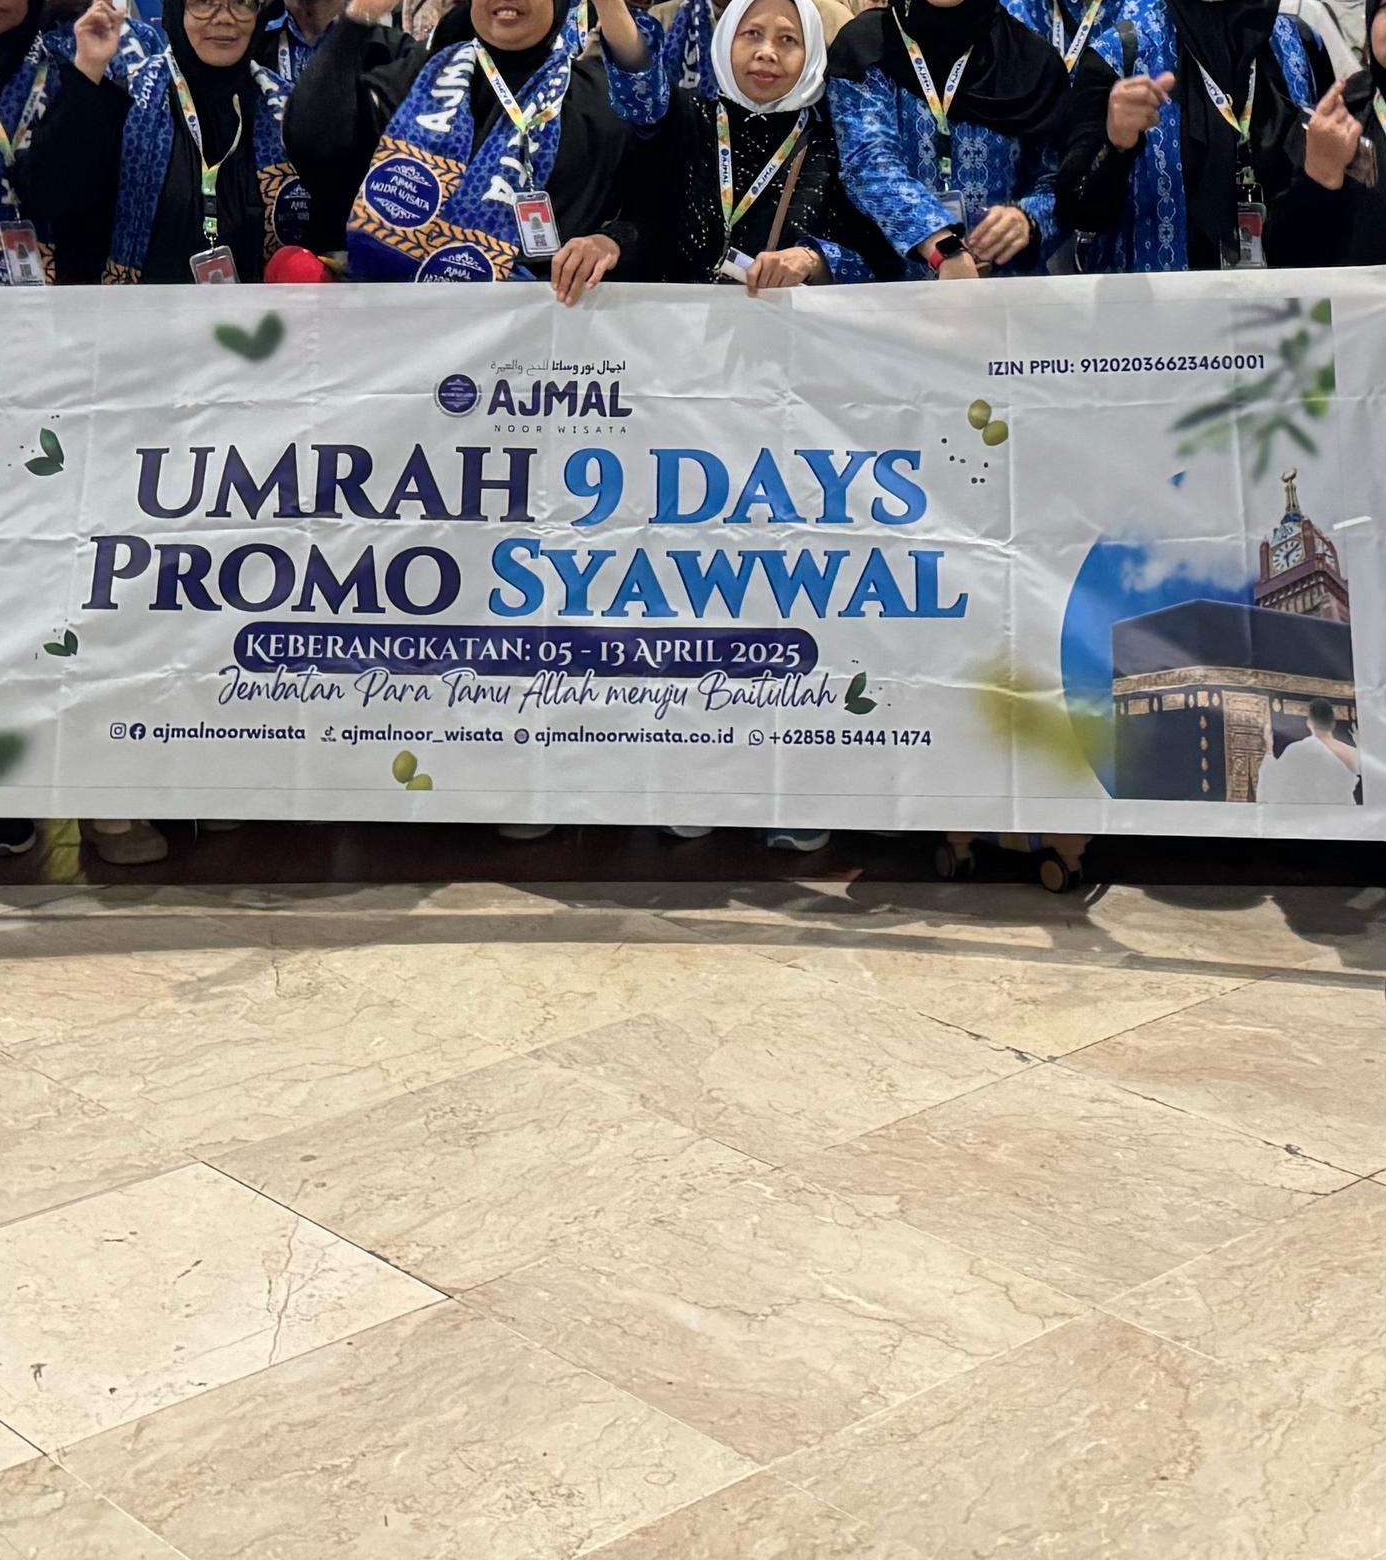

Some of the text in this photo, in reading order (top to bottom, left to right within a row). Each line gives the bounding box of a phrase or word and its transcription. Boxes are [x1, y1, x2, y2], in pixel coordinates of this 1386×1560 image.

[988, 360, 1024, 376] IZIN
[1029, 359, 1075, 375] PPIU:
[487, 378, 633, 418] AJMAL
[494, 424, 627, 435] NOOR WISATA
[135, 443, 929, 528] UMRAH 9 DAYS
[82, 535, 969, 620] PROMO SYAWWAL
[244, 633, 532, 665] KEBERANGKATAN:
[539, 638, 574, 664] 05
[599, 638, 629, 669] 13
[635, 637, 723, 667] APRIL
[729, 641, 802, 668] 2025
[218, 666, 346, 707] Jembatan
[354, 667, 432, 707] Para
[441, 669, 512, 705] Tamu
[517, 669, 601, 715] Allah
[702, 670, 838, 715] Baitullah
[152, 721, 932, 747] ajmalnoorwisata ajmalnoor_wisata ajmalnoorwisata.co.id +62858 5444 1474
